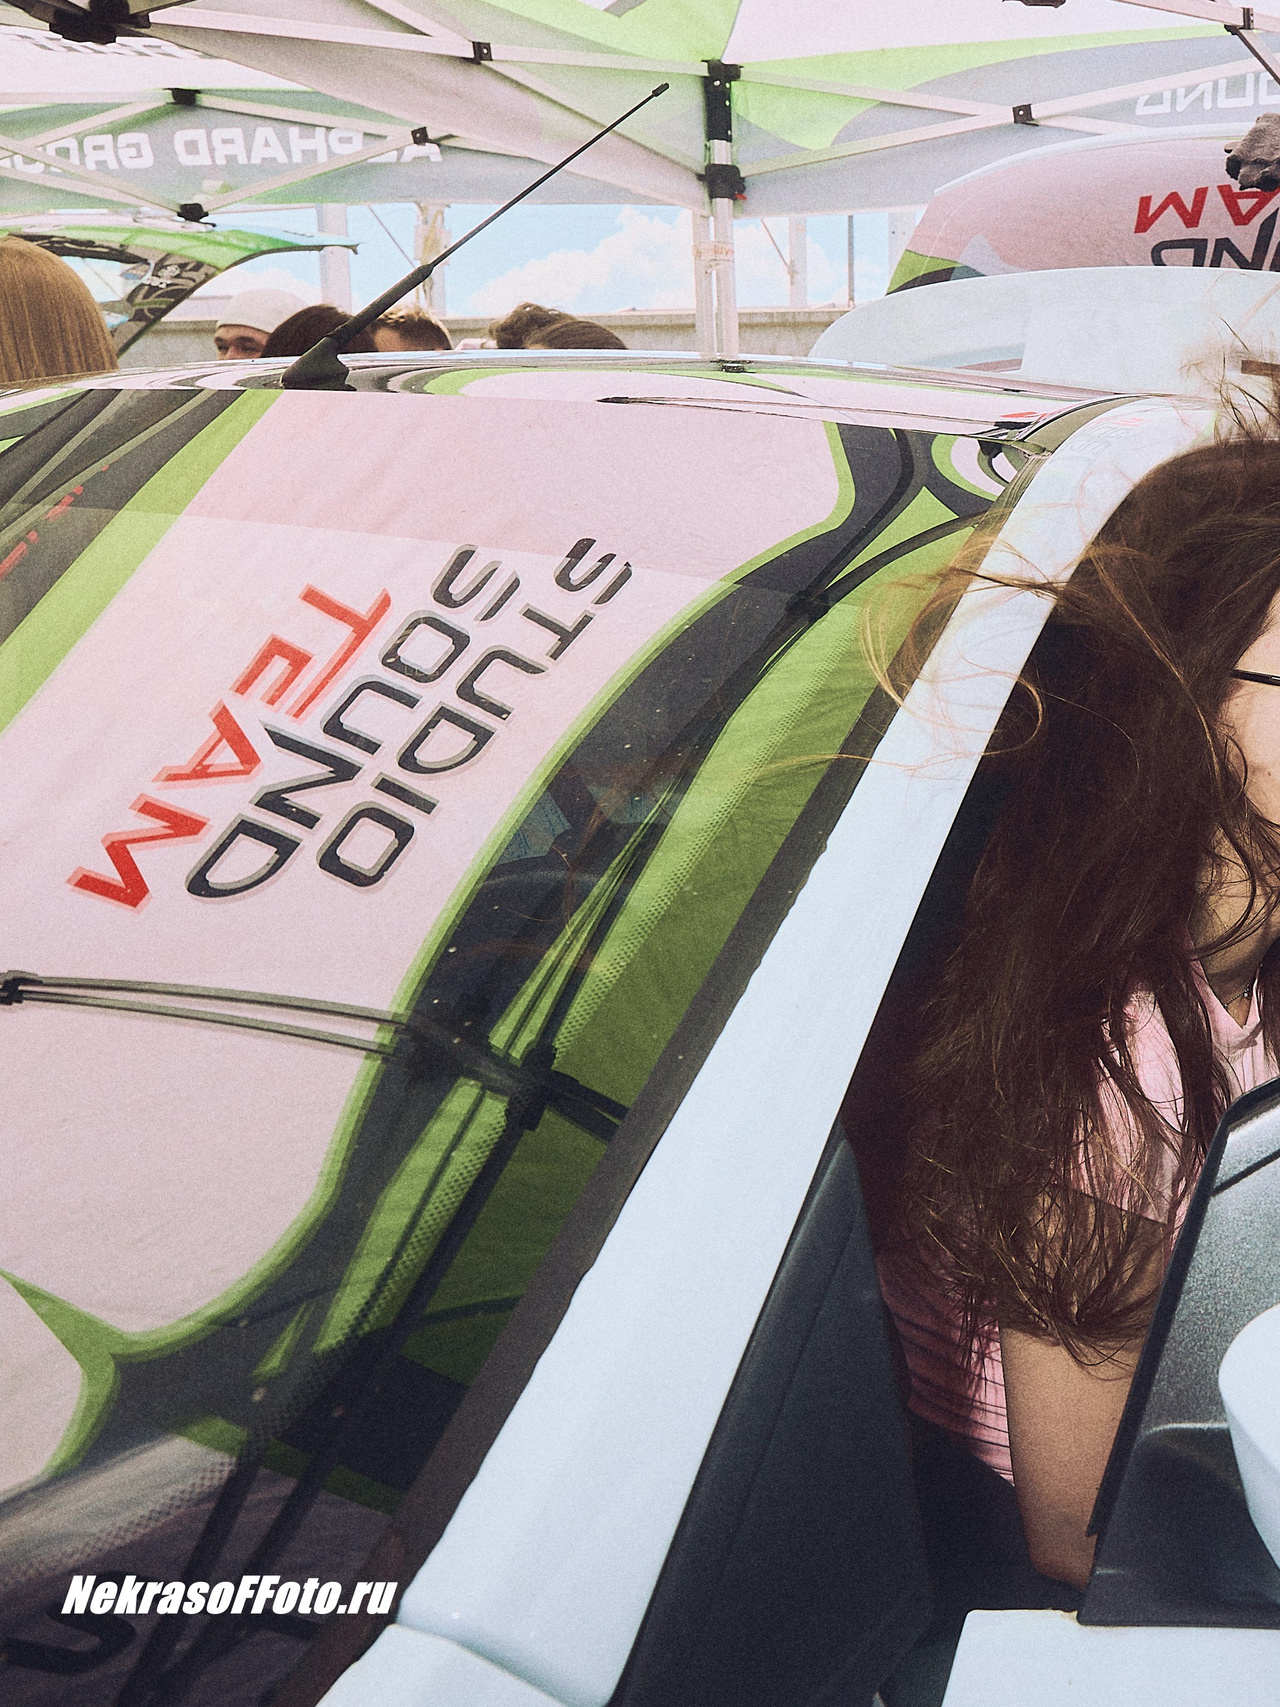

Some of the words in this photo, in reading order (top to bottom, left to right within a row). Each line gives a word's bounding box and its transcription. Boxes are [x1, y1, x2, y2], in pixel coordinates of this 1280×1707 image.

[66, 583, 392, 914] TEAM
[185, 543, 521, 902] SOUND
[316, 537, 633, 888] STUDIO
